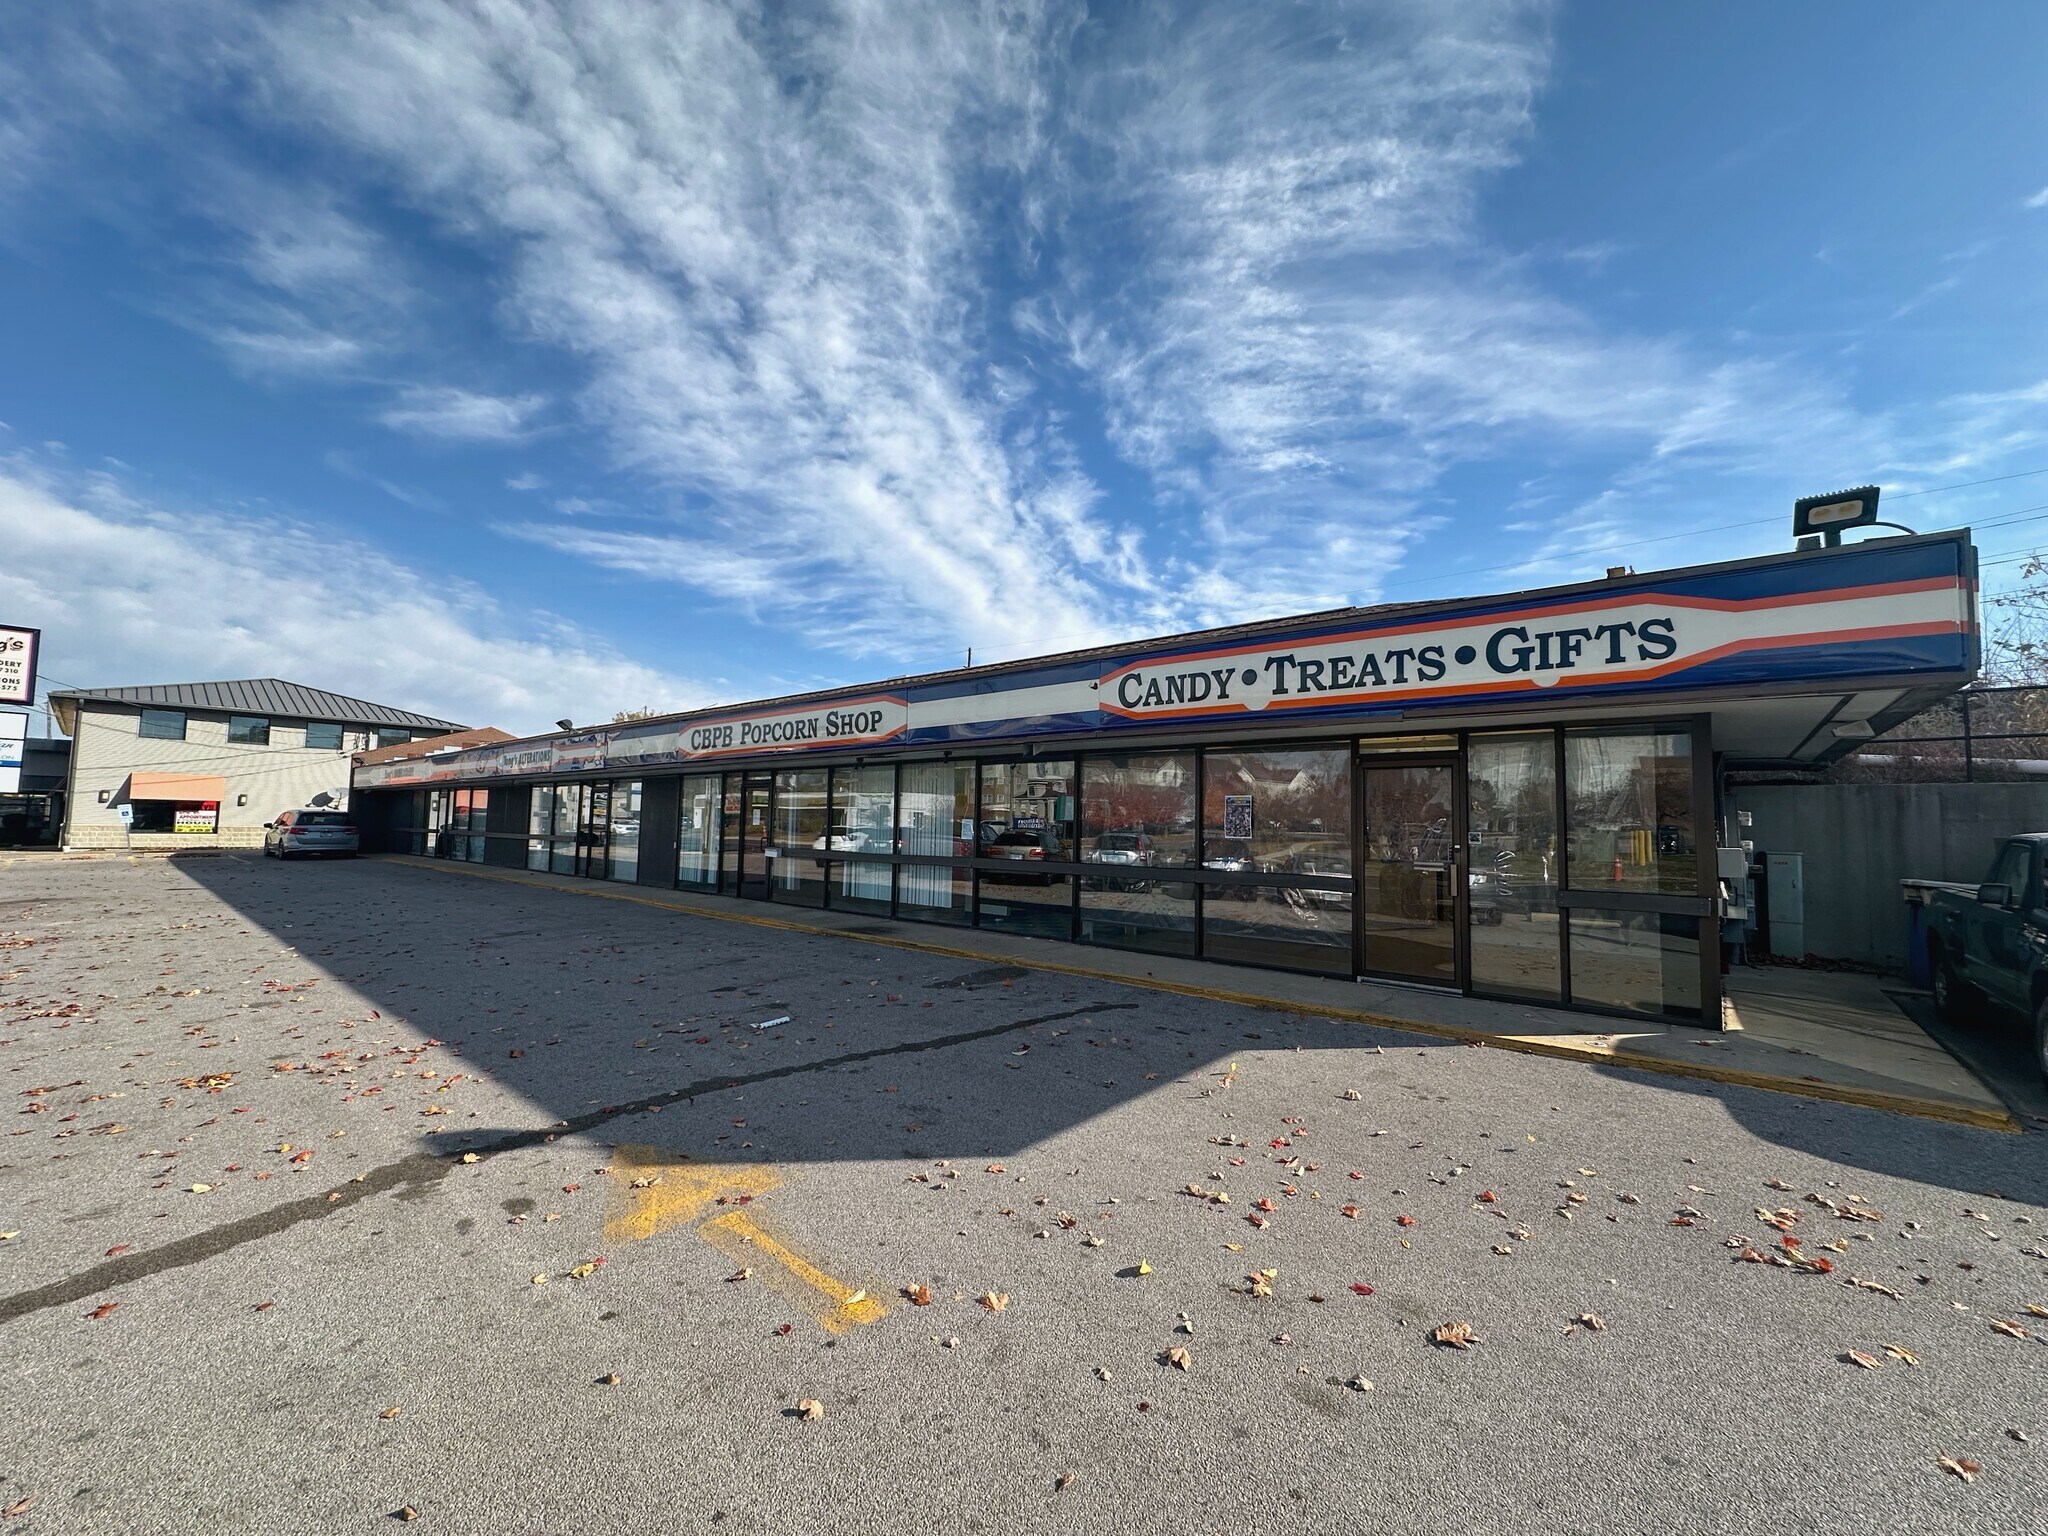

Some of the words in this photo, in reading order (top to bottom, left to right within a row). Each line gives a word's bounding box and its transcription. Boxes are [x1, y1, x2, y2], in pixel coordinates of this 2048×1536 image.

[1117, 667, 1236, 708] CANDY
[1265, 644, 1446, 695] TREATS
[1485, 617, 1677, 674] GIFTS
[0, 677, 21, 685] ONS
[691, 725, 733, 751] CBPB
[740, 718, 819, 745] POPCORN
[826, 710, 883, 737] SHOP
[518, 749, 550, 765] ALTERATIONS
